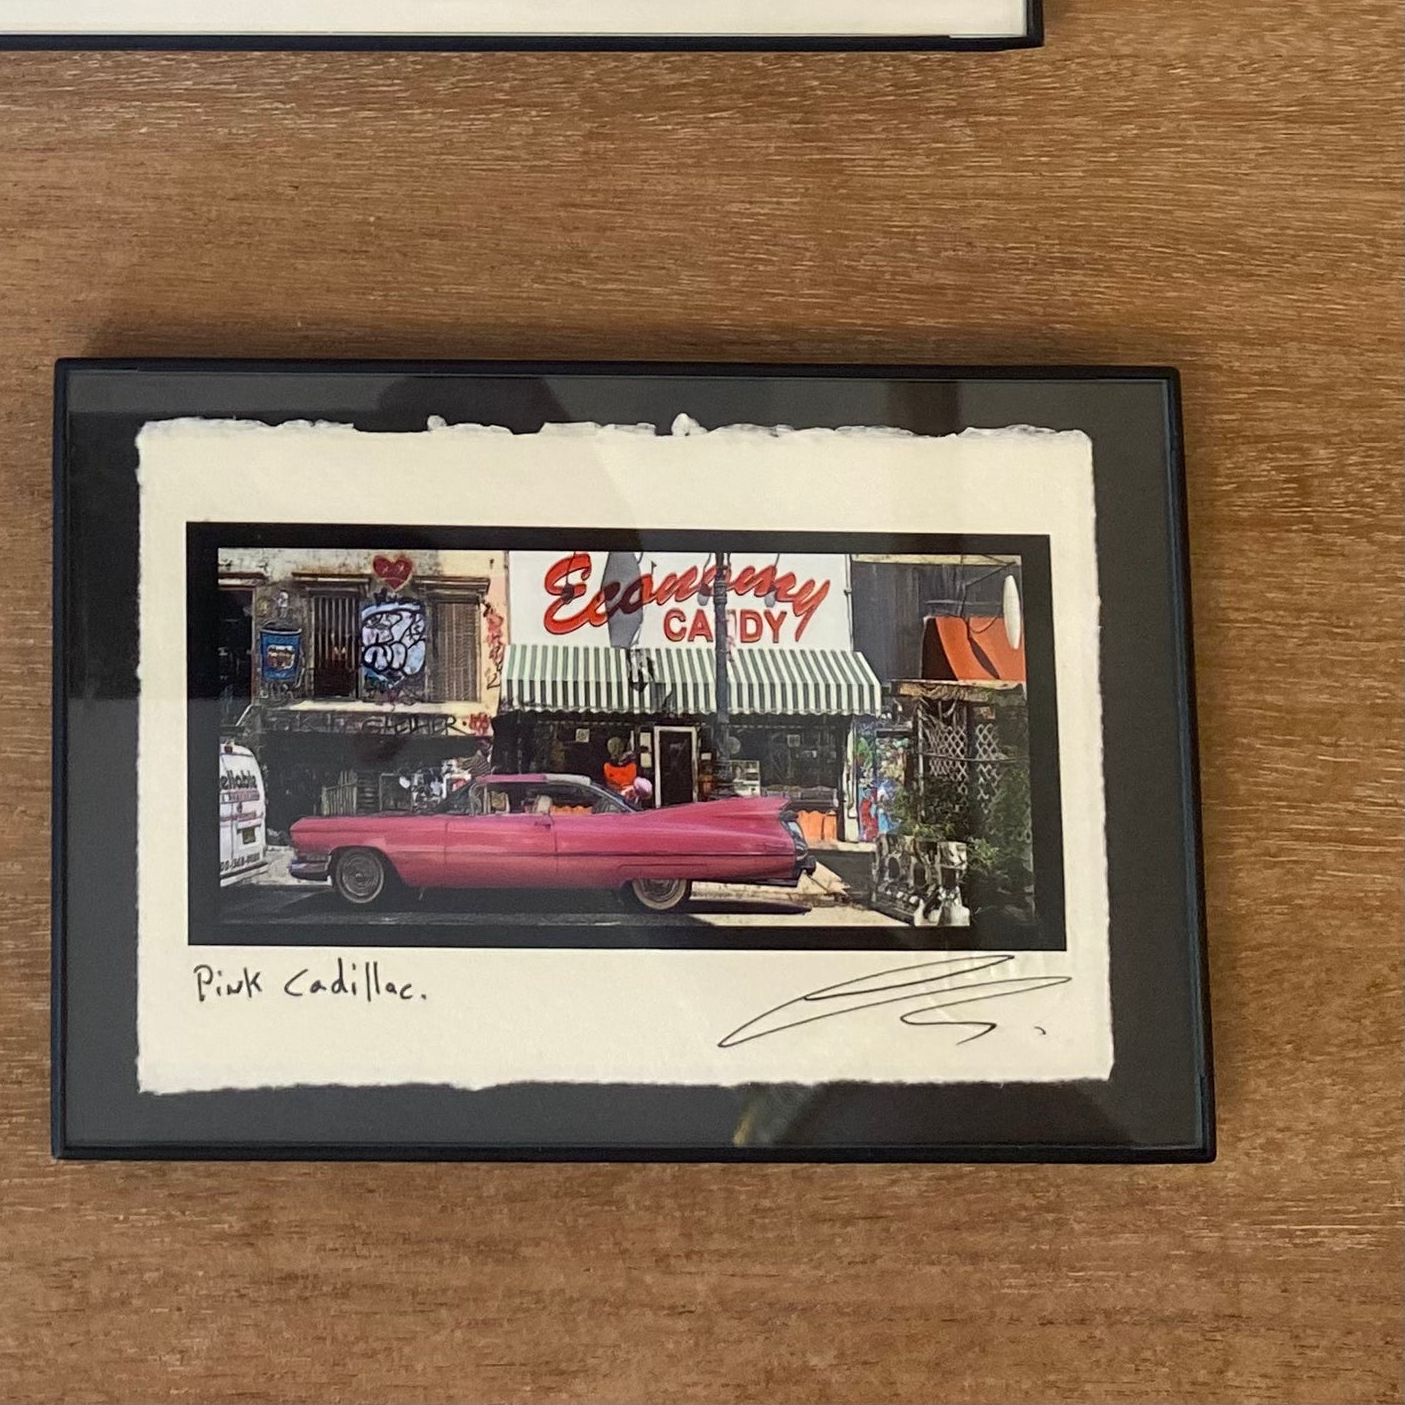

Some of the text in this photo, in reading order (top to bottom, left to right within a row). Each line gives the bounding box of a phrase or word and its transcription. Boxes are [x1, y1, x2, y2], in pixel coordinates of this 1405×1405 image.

[662, 607, 788, 644] CADY
[192, 957, 428, 1003] Pink Cadillac.
